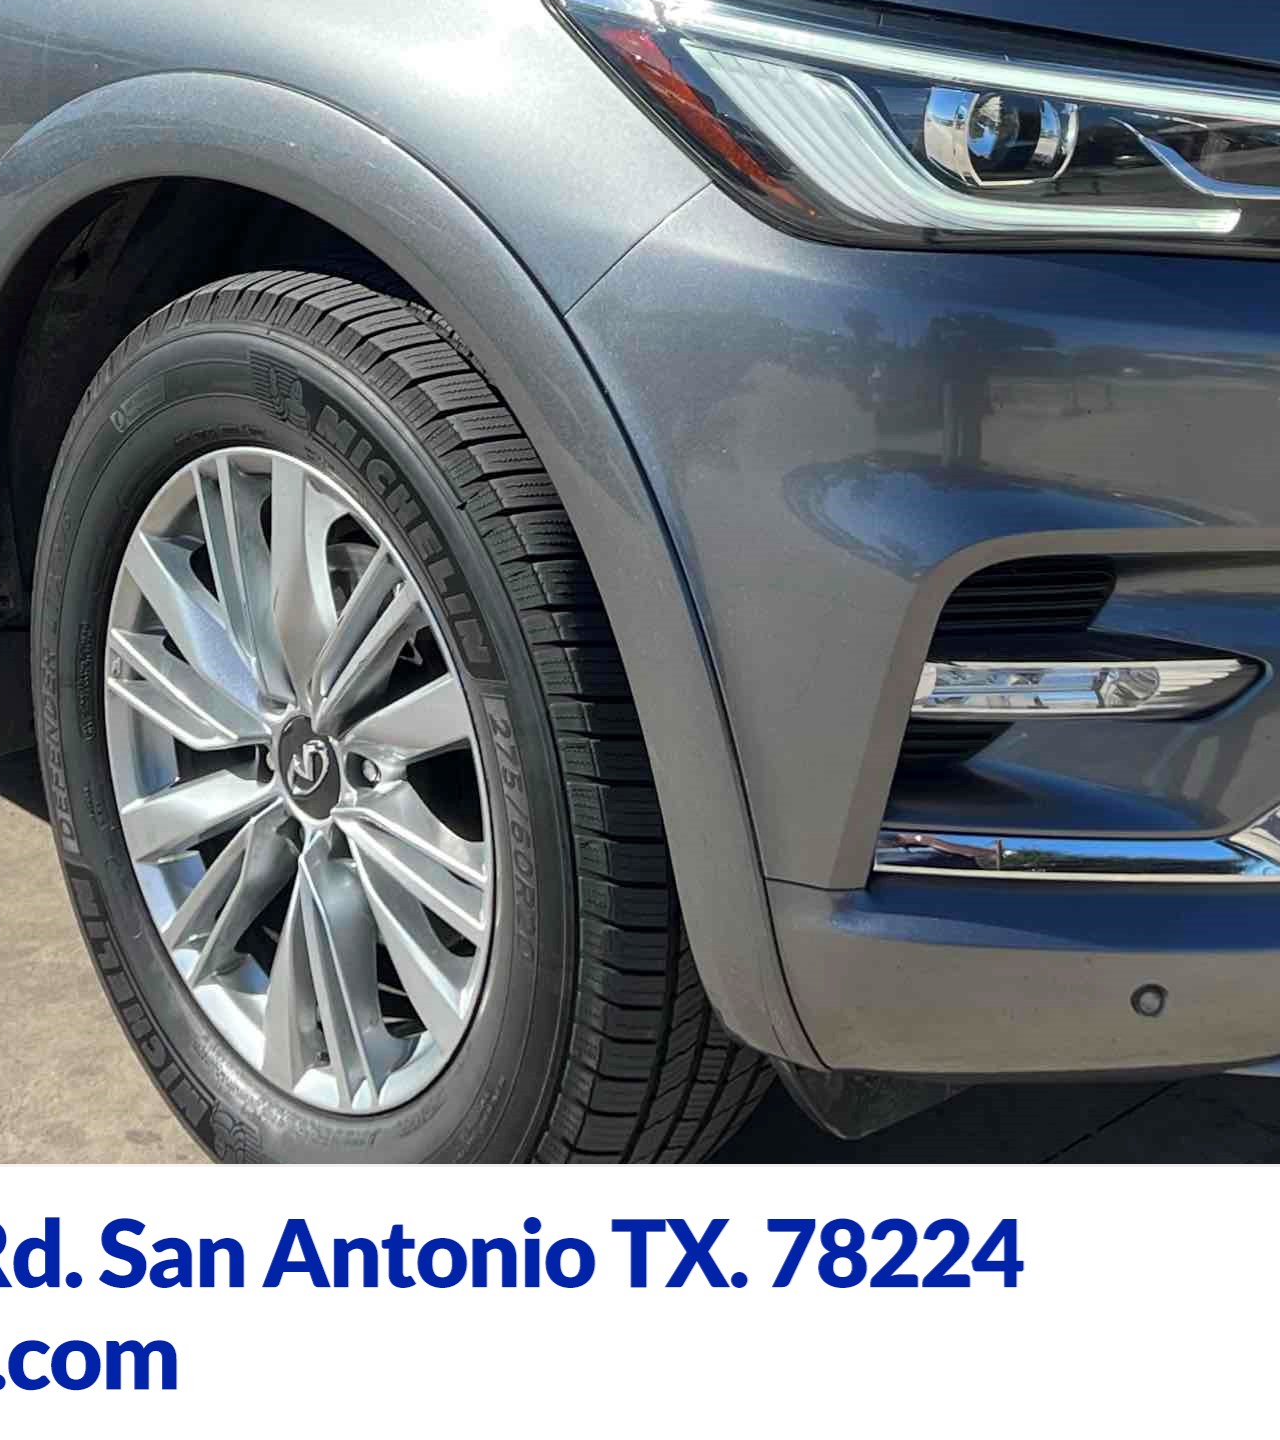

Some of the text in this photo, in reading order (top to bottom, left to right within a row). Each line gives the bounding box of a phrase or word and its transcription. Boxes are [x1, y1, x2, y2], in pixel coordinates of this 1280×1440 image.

[315, 404, 494, 664] MICHELIN
[40, 648, 76, 846] DEFENDER
[70, 876, 210, 1129] MICHELIN
